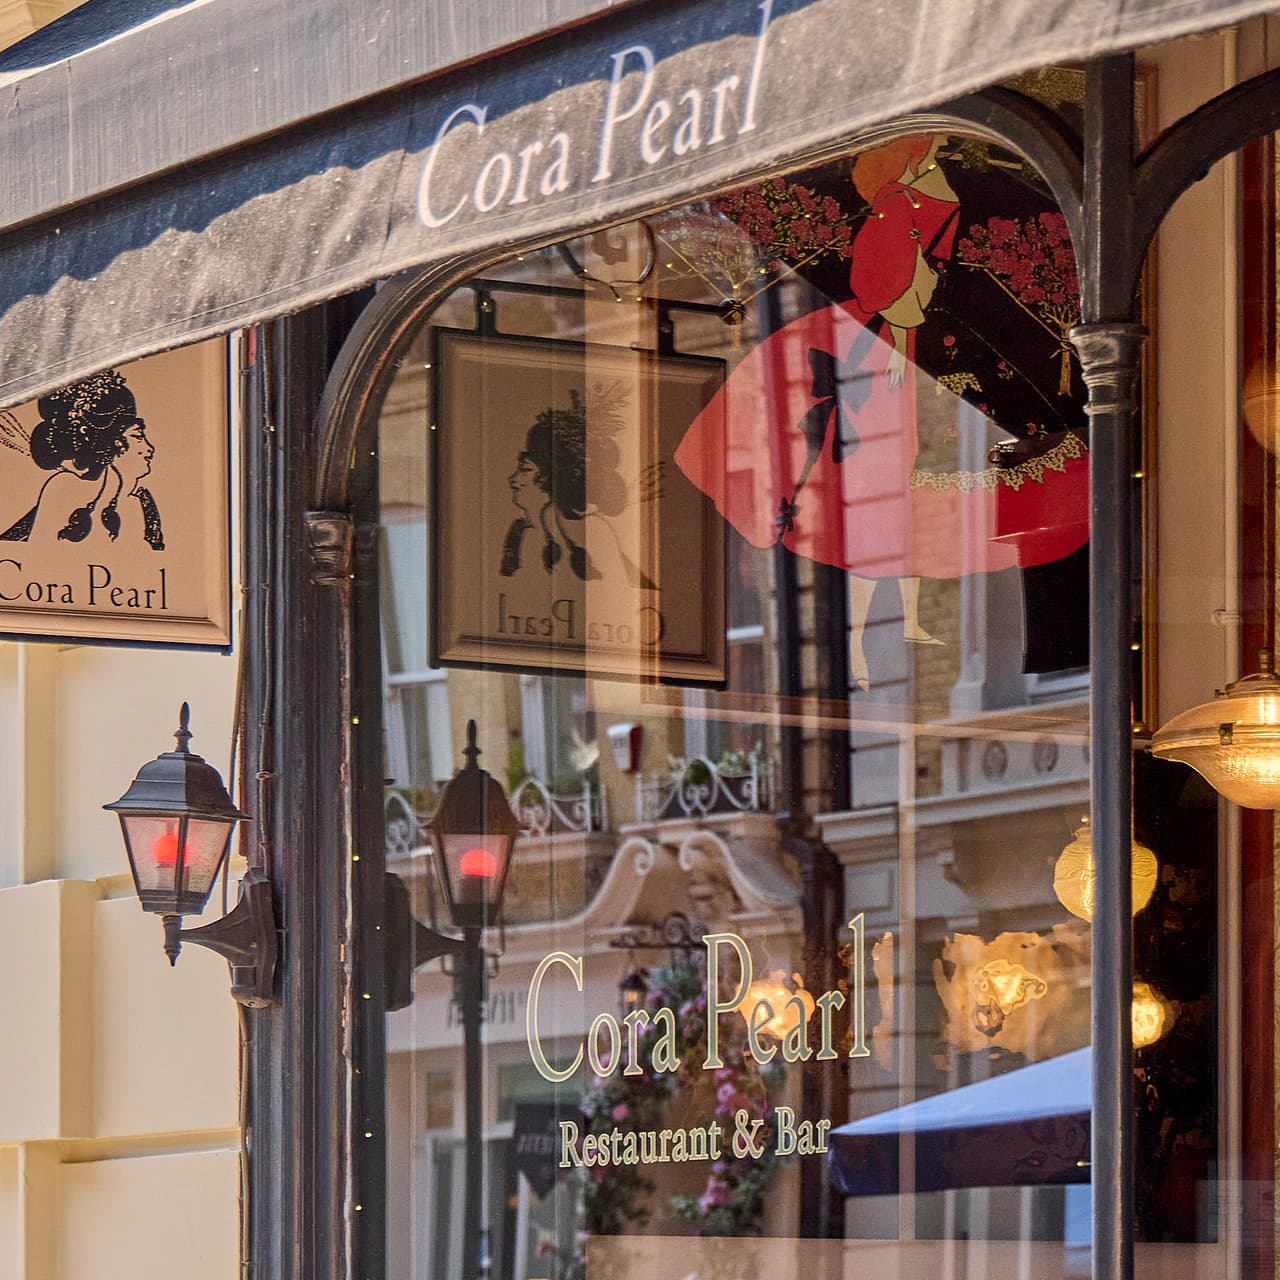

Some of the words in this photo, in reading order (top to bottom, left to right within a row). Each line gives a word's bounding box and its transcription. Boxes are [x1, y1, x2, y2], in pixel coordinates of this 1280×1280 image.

[417, 103, 571, 229] Cora
[592, 0, 772, 183] Pearl
[87, 564, 169, 610] Pearl
[526, 951, 681, 1083] Cora
[702, 912, 871, 1070] Pearl
[559, 1120, 722, 1168] Restaurant
[732, 1109, 765, 1159] &
[775, 1106, 832, 1156] Bar
